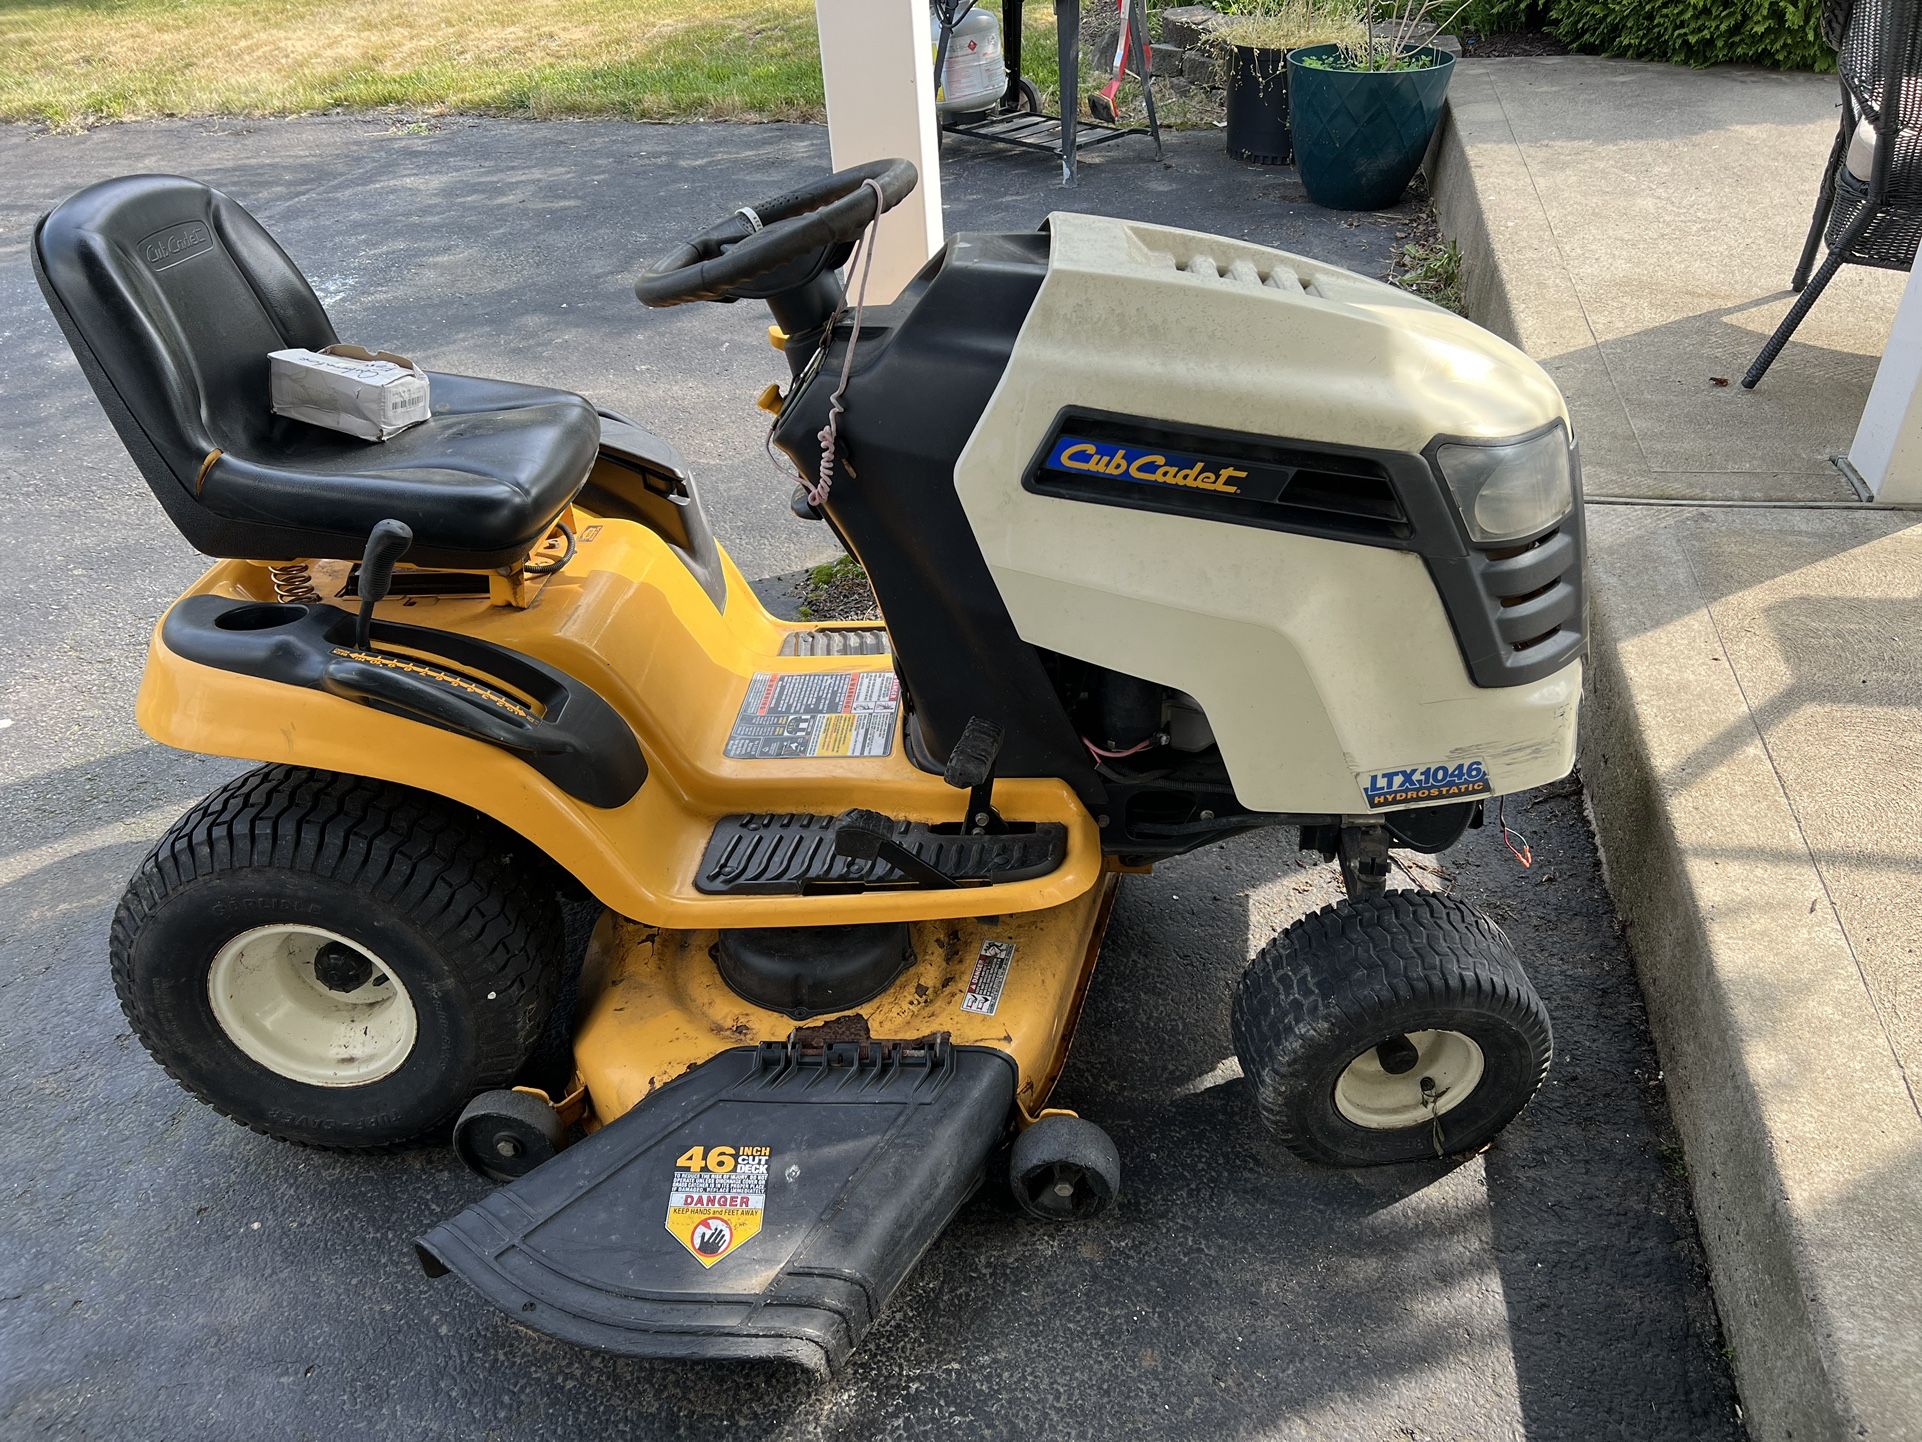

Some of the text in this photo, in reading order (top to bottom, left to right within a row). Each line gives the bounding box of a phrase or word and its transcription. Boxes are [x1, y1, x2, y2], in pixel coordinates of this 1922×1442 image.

[146, 227, 206, 263] Cub Cadet
[1060, 443, 1248, 493] Cub Cadet
[1374, 782, 1484, 804] HYDROSTATIC
[676, 1146, 736, 1173] 46
[738, 1156, 768, 1164] CUT
[739, 1147, 770, 1156] INCH
[737, 1164, 768, 1173] DECK
[684, 1195, 750, 1207] DANGER
